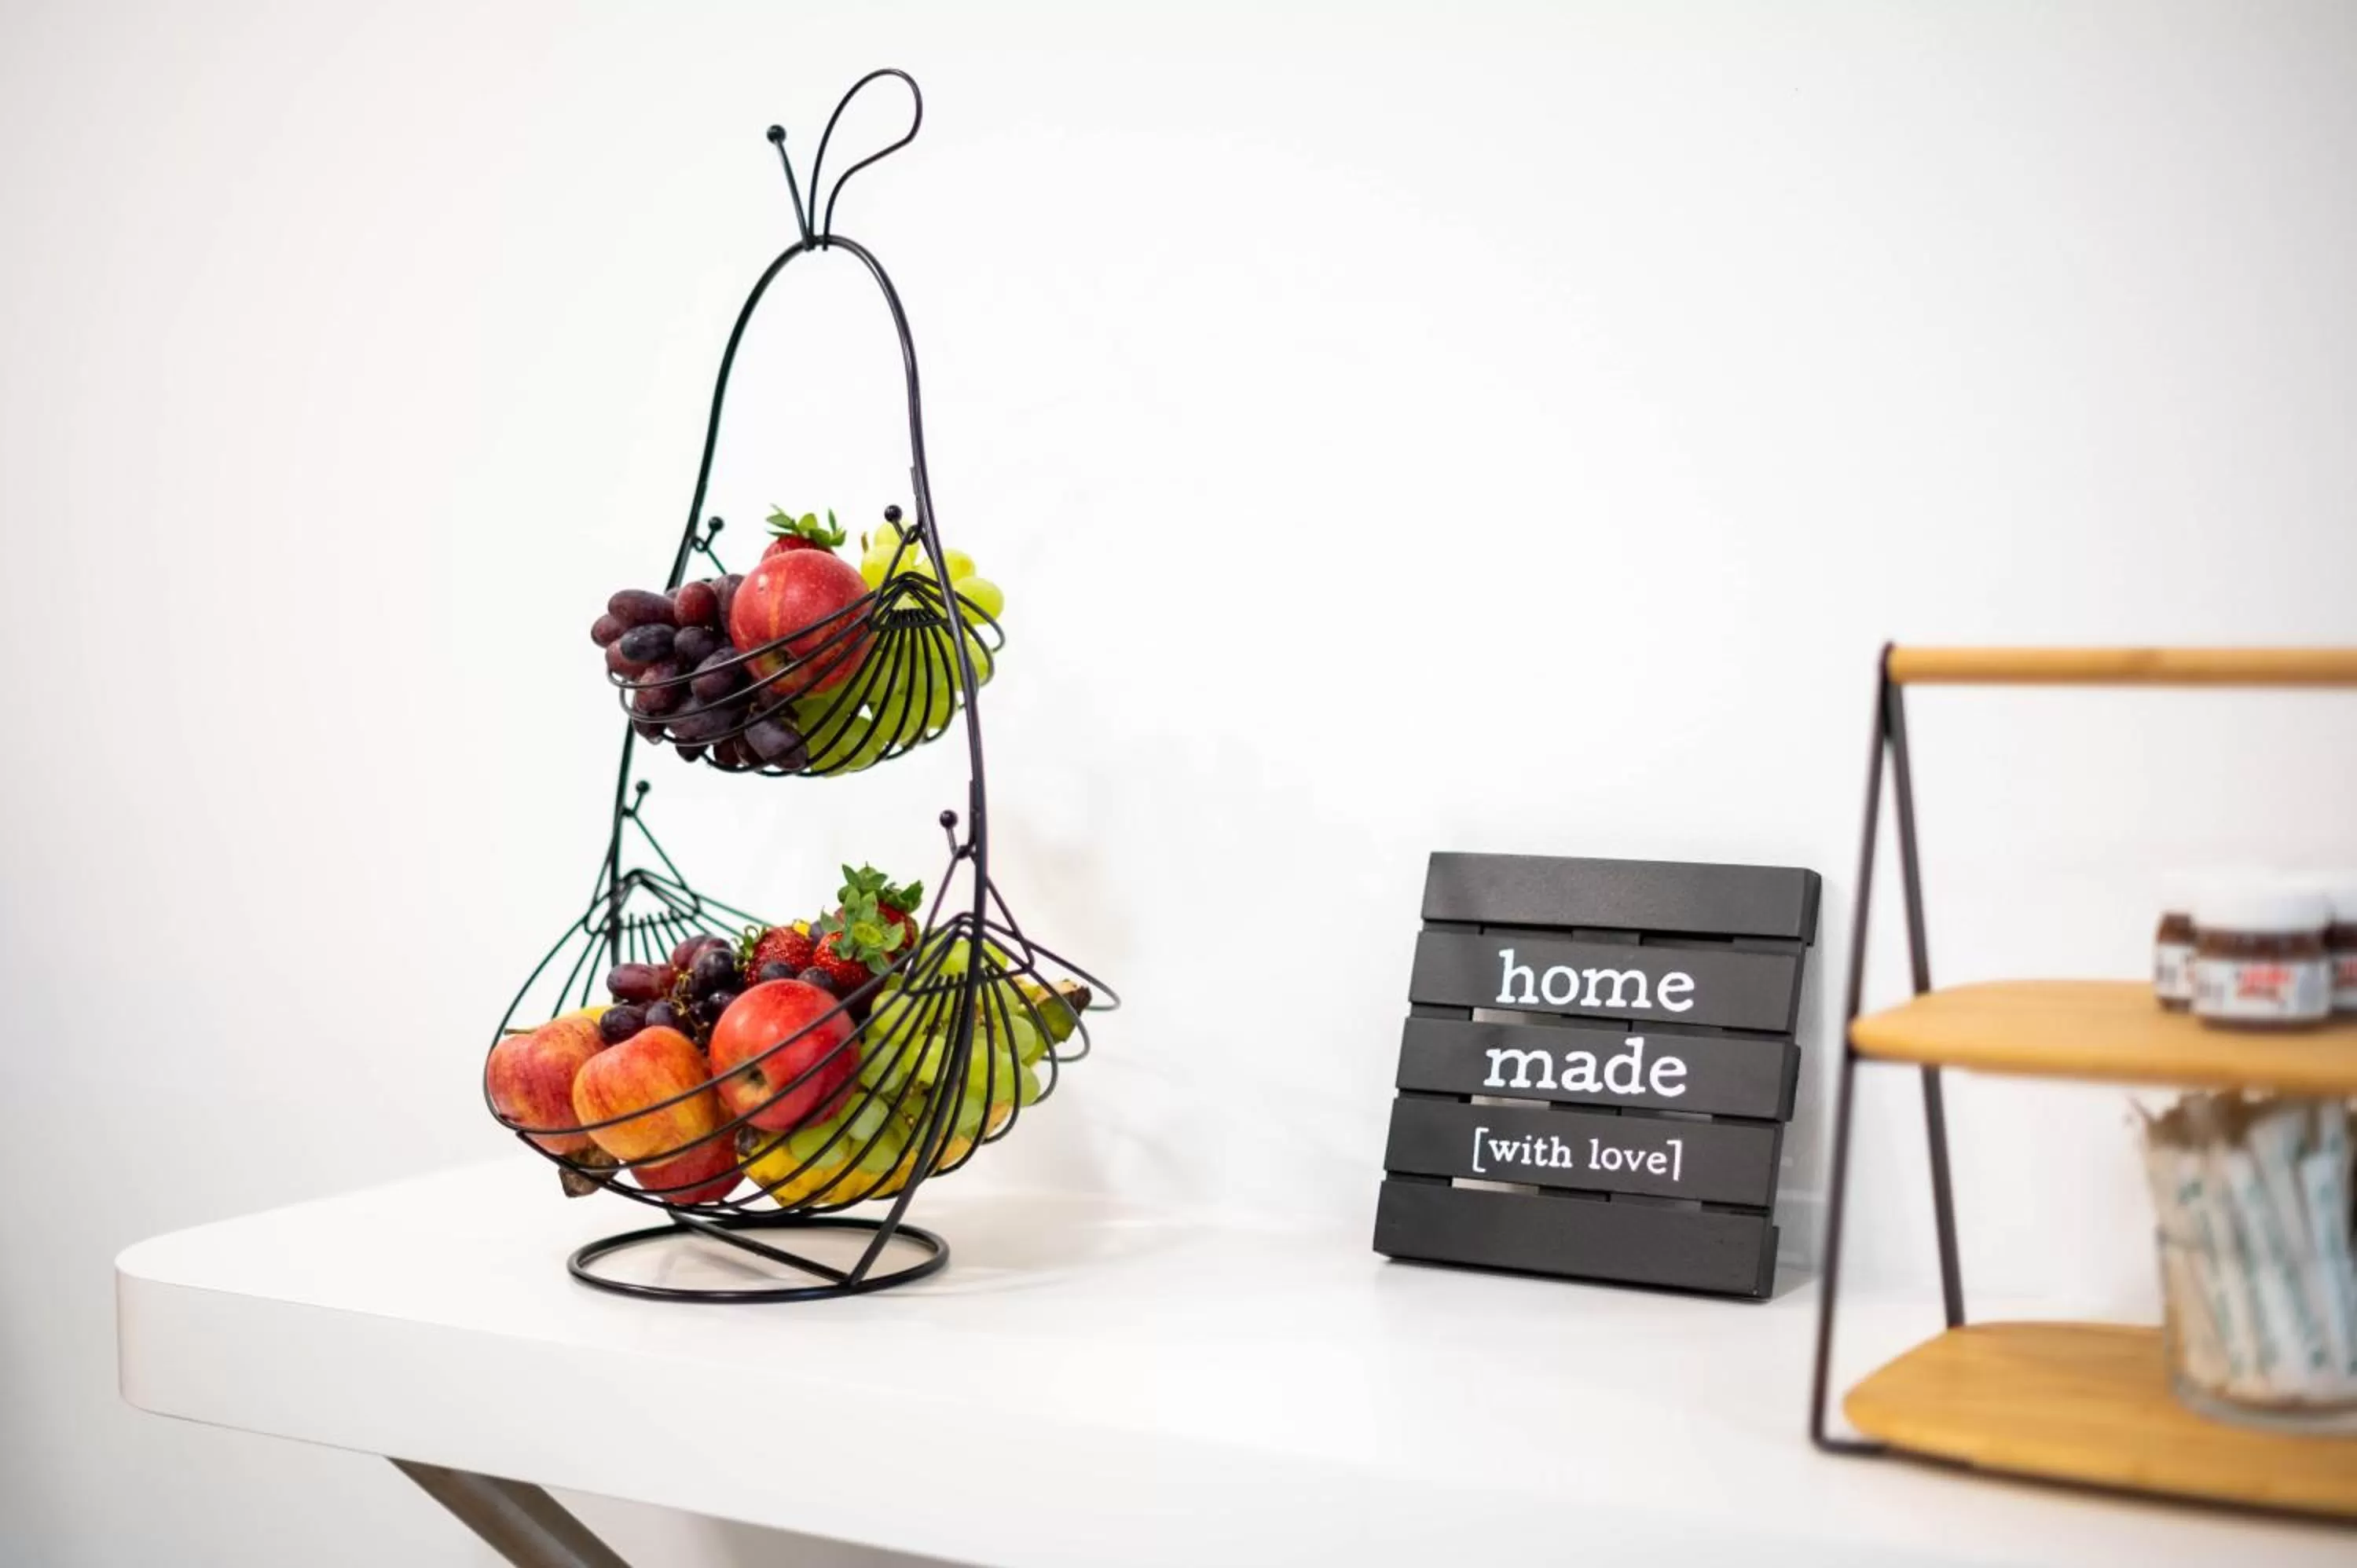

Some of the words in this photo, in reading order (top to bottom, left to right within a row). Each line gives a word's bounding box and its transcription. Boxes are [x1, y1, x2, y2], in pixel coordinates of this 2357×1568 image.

[1495, 948, 1695, 1013] home
[1483, 1036, 1688, 1097] made
[1472, 1127, 1573, 1173] [with
[1588, 1138, 1683, 1181] love]
